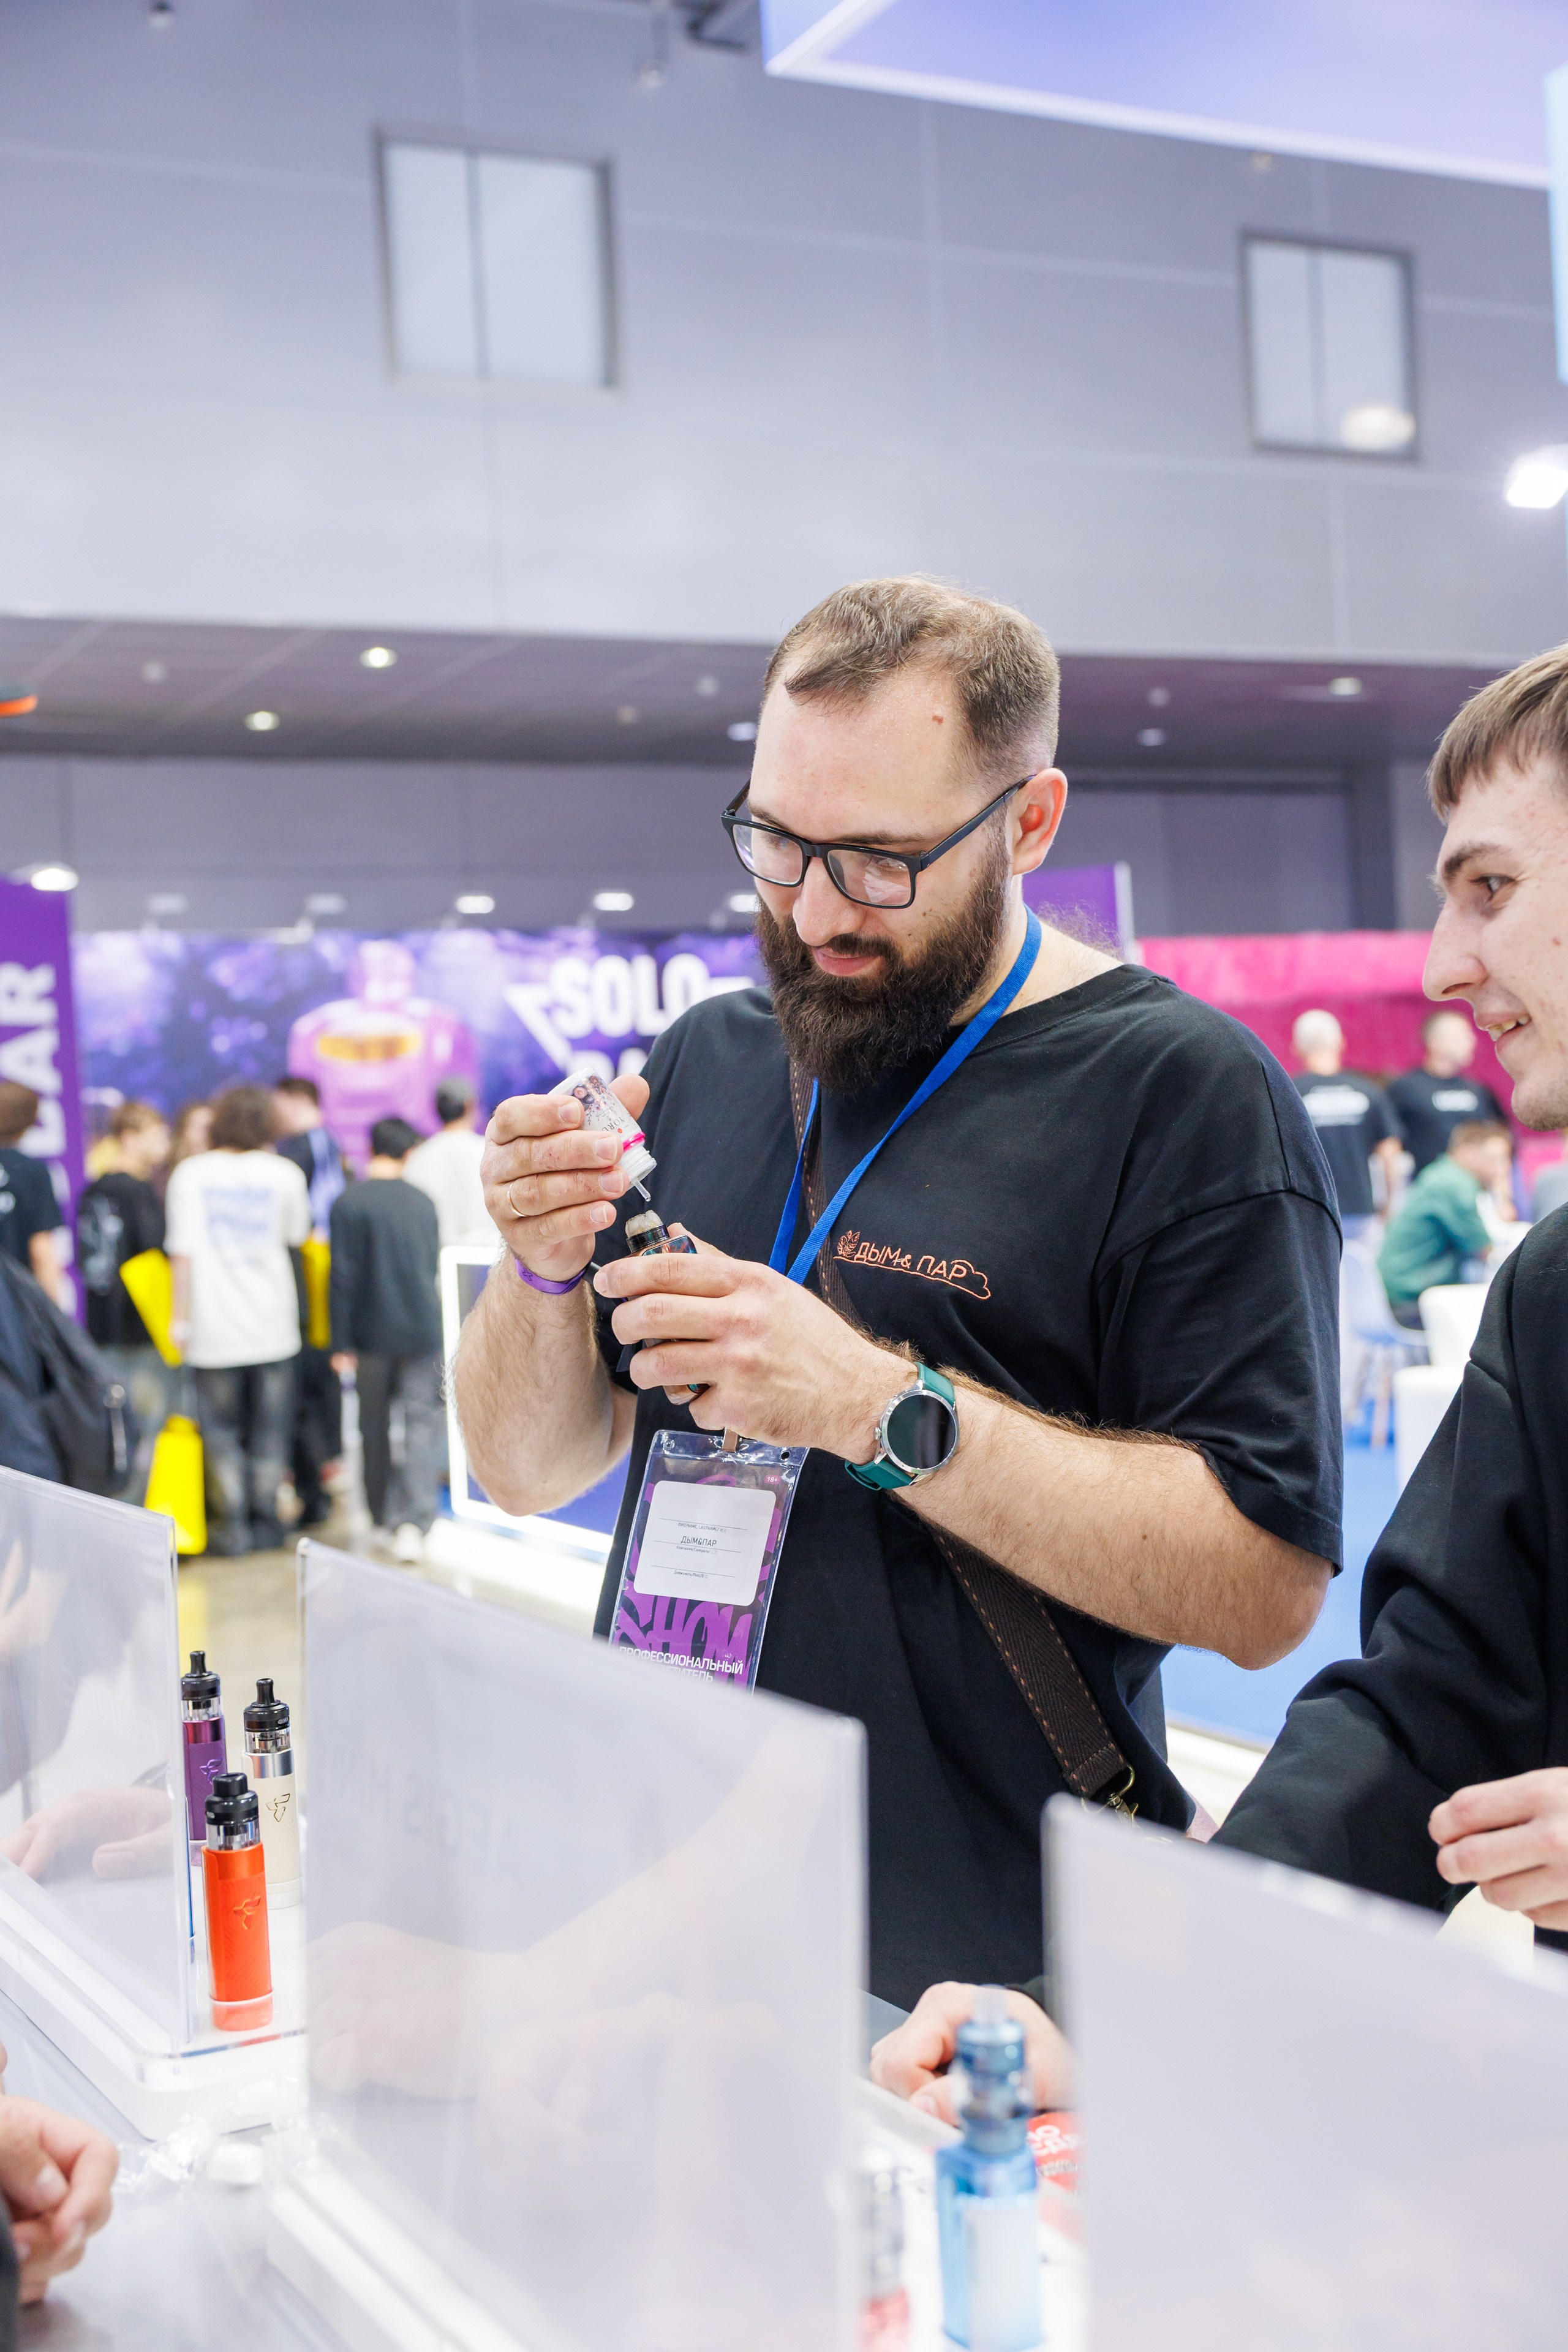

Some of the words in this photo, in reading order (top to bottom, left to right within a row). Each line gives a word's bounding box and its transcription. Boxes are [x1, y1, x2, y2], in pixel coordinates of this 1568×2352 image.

[547, 953, 710, 1038] SOLO
[916, 1255, 967, 1280] ПАР
[680, 1536, 717, 1547] ДЫМ&ПАР
[619, 1646, 744, 1675] ПРОФЕССИОНАЛЬНЫЙ
